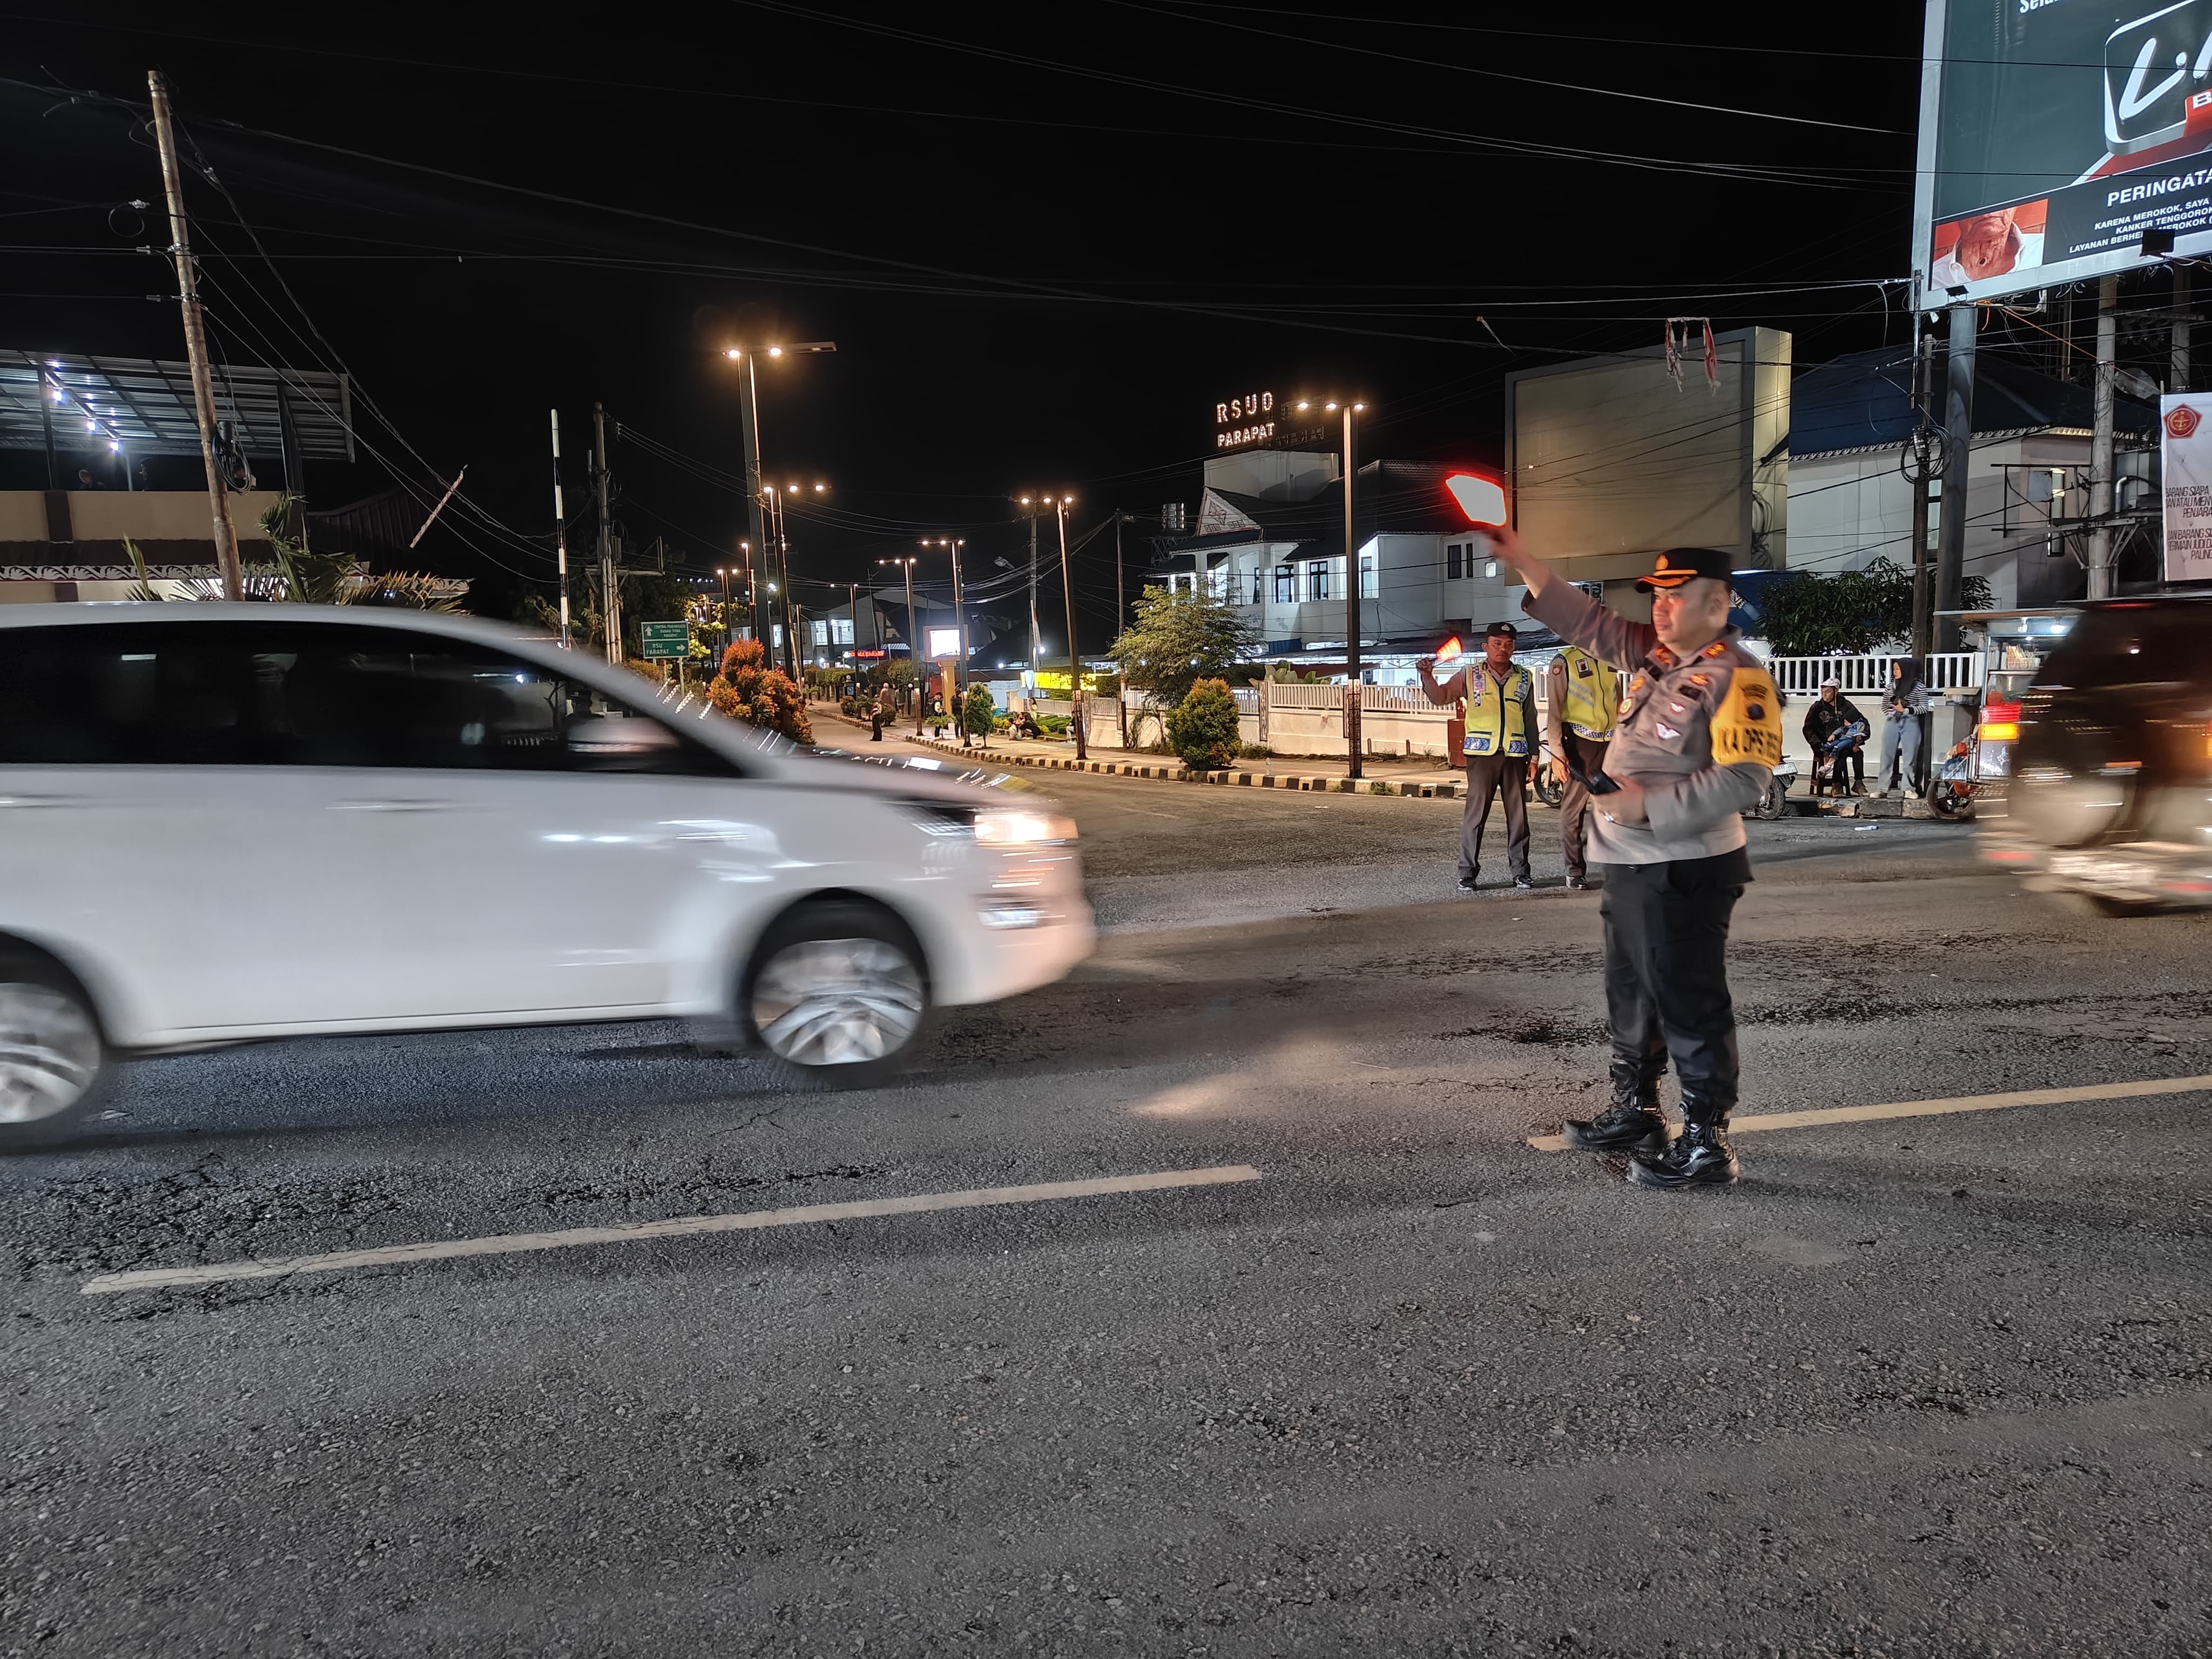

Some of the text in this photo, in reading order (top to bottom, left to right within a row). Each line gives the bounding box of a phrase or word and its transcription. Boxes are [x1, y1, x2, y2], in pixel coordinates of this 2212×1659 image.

[2094, 198, 2209, 230] KARENA MEROKOK, SAYA
[2115, 220, 2153, 234] KANKER
[2069, 238, 2108, 253] LAYANAN
[2110, 231, 2143, 244] BERHE
[1216, 390, 1273, 423] RSUD
[1217, 422, 1275, 448] PARAPAT
[2189, 485, 2209, 496] SIAPA
[2177, 528, 2204, 540] BARANG
